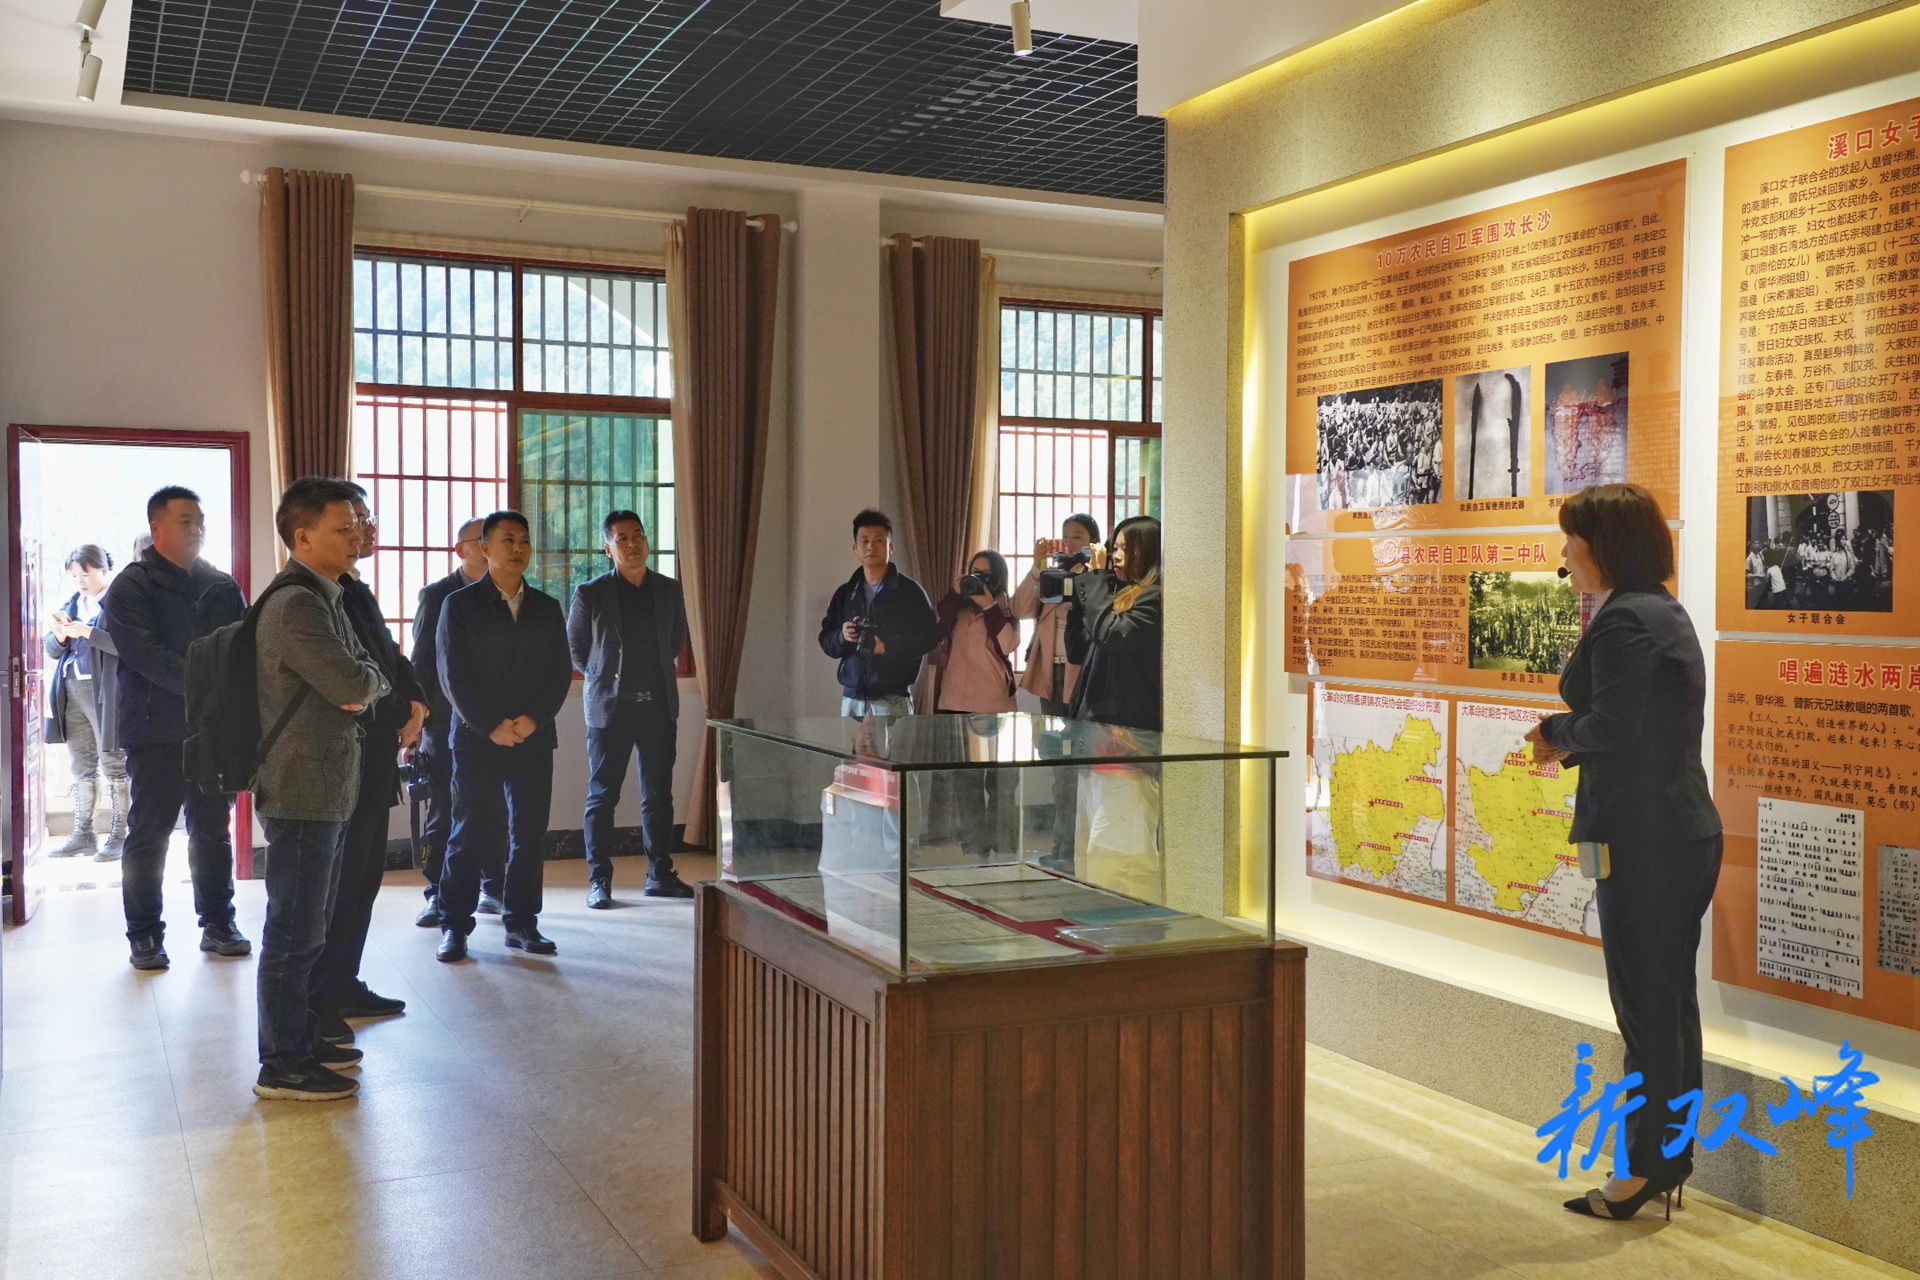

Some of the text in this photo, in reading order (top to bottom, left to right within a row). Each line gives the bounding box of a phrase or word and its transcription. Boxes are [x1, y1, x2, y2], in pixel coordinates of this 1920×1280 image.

[1828, 113, 1920, 161] 溪口女子
[1376, 208, 1553, 271] 10万农民自卫军围攻长沙
[1459, 498, 1525, 513] 农民自卫军使用的武器
[1373, 543, 1547, 565] 湘乡县农民自卫队第二中队
[1787, 612, 1845, 624] 女子联合会
[1501, 672, 1544, 684] 农民自卫队
[1779, 659, 1920, 691] 唱遍涟水两岸
[1727, 724, 1920, 750] 资产阶级反把我们欺。起来！起来！齐心
